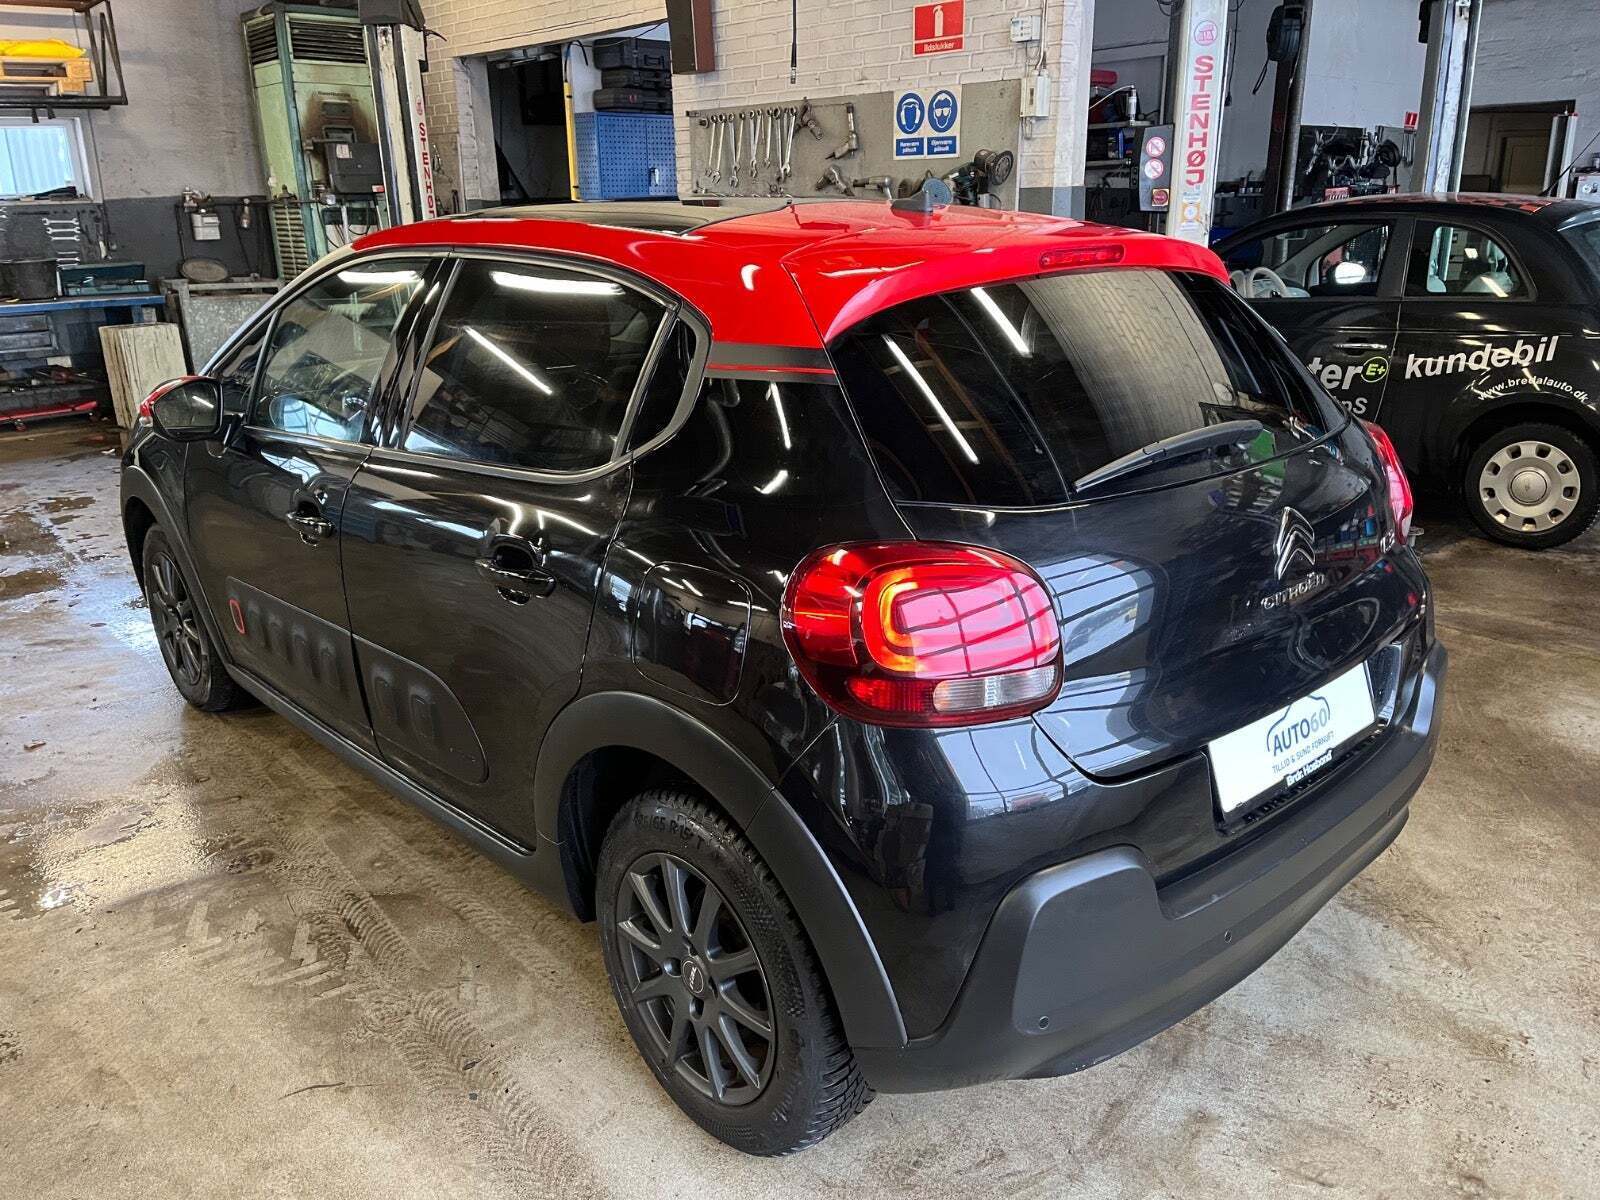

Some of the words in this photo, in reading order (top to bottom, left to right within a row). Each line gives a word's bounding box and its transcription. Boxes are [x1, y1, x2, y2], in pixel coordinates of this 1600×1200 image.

[1186, 55, 1214, 186] STENHØJ
[1405, 336, 1559, 380] kundebil
[1478, 375, 1589, 403] www.bredalauto.dk
